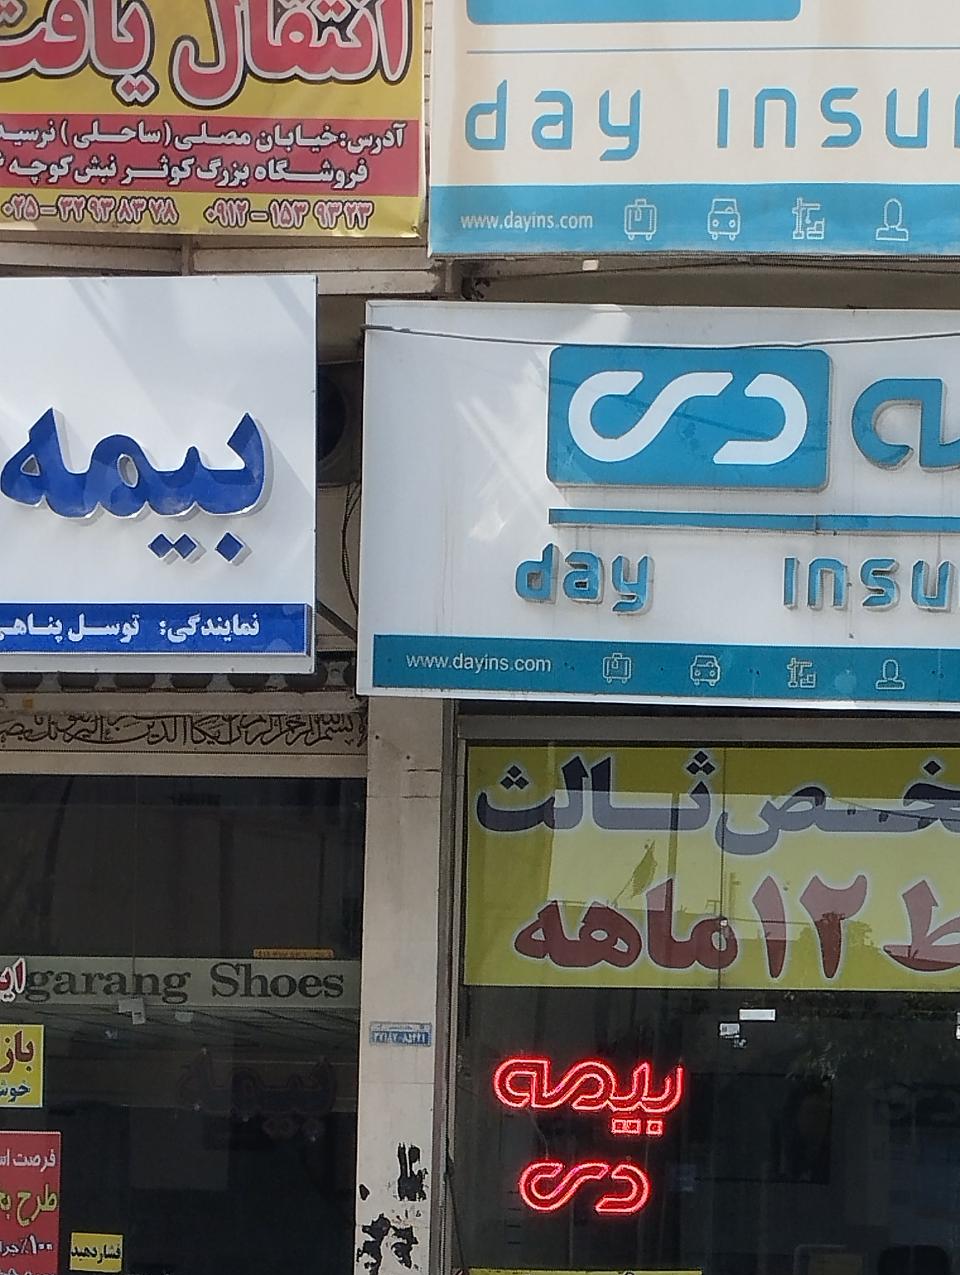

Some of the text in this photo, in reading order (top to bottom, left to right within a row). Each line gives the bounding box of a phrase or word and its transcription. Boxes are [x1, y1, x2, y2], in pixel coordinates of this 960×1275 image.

[174, 121, 251, 152] مصلی
[465, 79, 641, 162] day
[255, 123, 338, 154] خیابان
[9, 155, 73, 184] کوچه
[73, 153, 118, 184] نبش
[120, 154, 195, 187] کوثر
[196, 157, 251, 187] بزرگ
[254, 157, 369, 190] فروشگاه
[460, 210, 594, 233] www.dayins.com
[0, 405, 268, 562] بیمه
[514, 543, 653, 615] day
[68, 613, 141, 643] توسل
[406, 652, 552, 674] www.dayins.com
[475, 750, 716, 834] ثالث
[511, 876, 741, 972] ماهه
[752, 872, 869, 980] ۱۲
[210, 962, 345, 999] Shoes
[492, 1055, 686, 1137] بیمه
[12, 1148, 57, 1173] فرصت
[16, 1183, 58, 1227] طرح
[71, 1243, 122, 1265] فشار دهید
